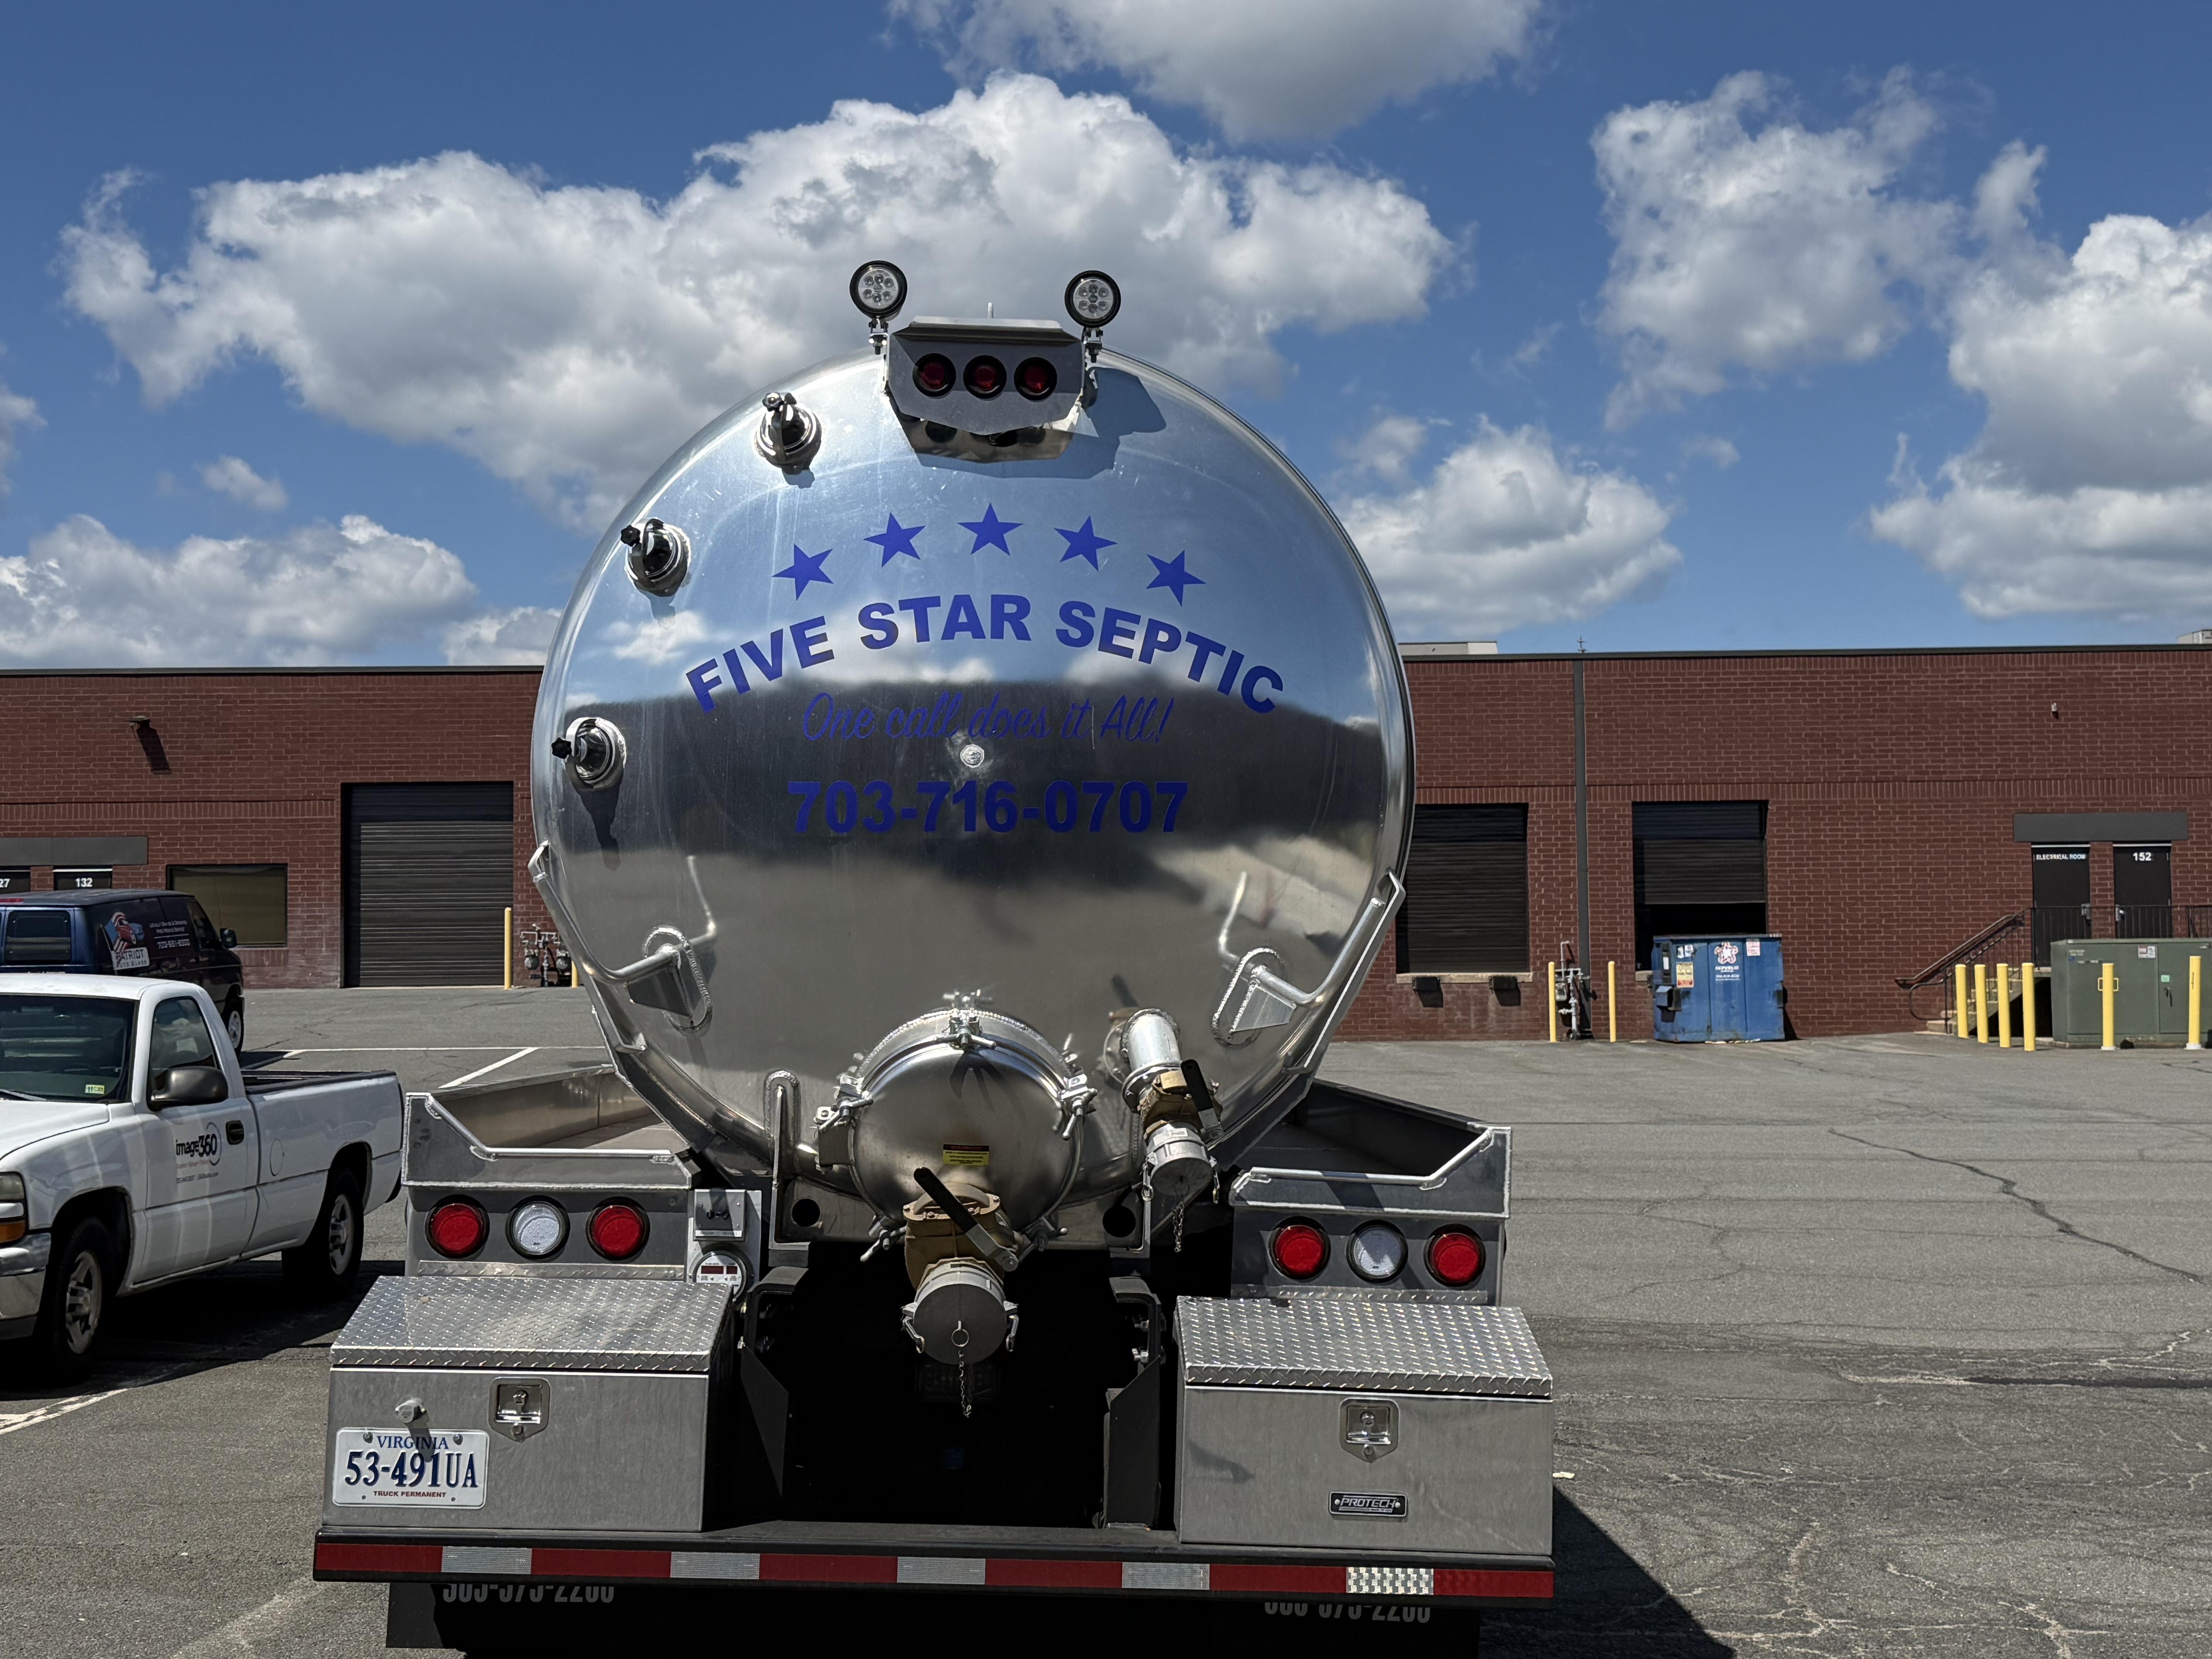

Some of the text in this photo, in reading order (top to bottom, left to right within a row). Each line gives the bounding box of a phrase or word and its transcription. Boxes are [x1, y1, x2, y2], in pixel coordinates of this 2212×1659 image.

[686, 594, 1283, 714] FIVE STAR SEPTIC
[802, 691, 1175, 743] One call does it All!
[787, 779, 1188, 833] 703-716-0707
[2133, 852, 2152, 861] 152
[76, 878, 93, 887] 132
[176, 1133, 217, 1158] image360
[377, 1435, 449, 1449] VIRGINIA
[344, 1450, 478, 1488] 53-491UA
[1340, 1498, 1396, 1508] PROTECH
